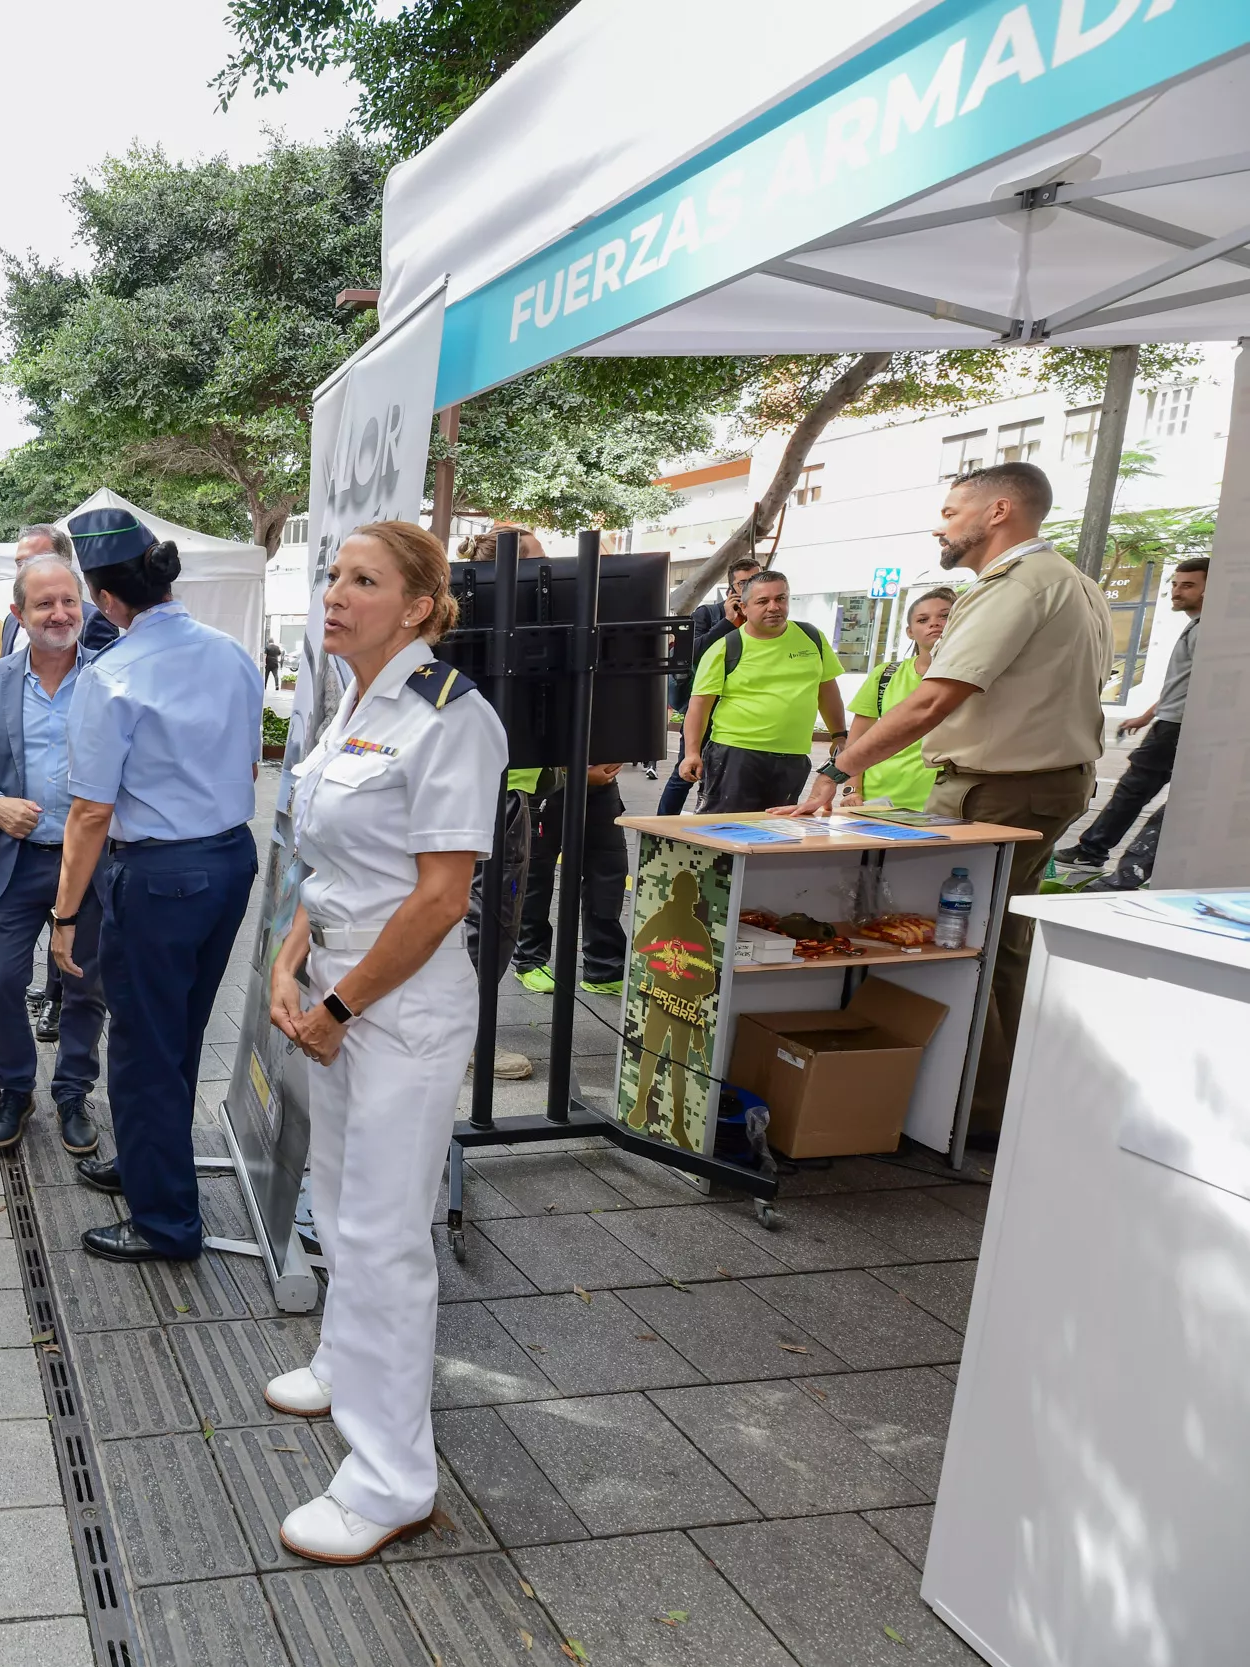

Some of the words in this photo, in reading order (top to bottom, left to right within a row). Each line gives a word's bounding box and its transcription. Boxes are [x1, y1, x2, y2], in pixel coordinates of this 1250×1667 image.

[510, 169, 745, 343] FUERZAS
[759, 0, 1175, 214] ARMAD
[662, 1001, 706, 1028] TIERRA
